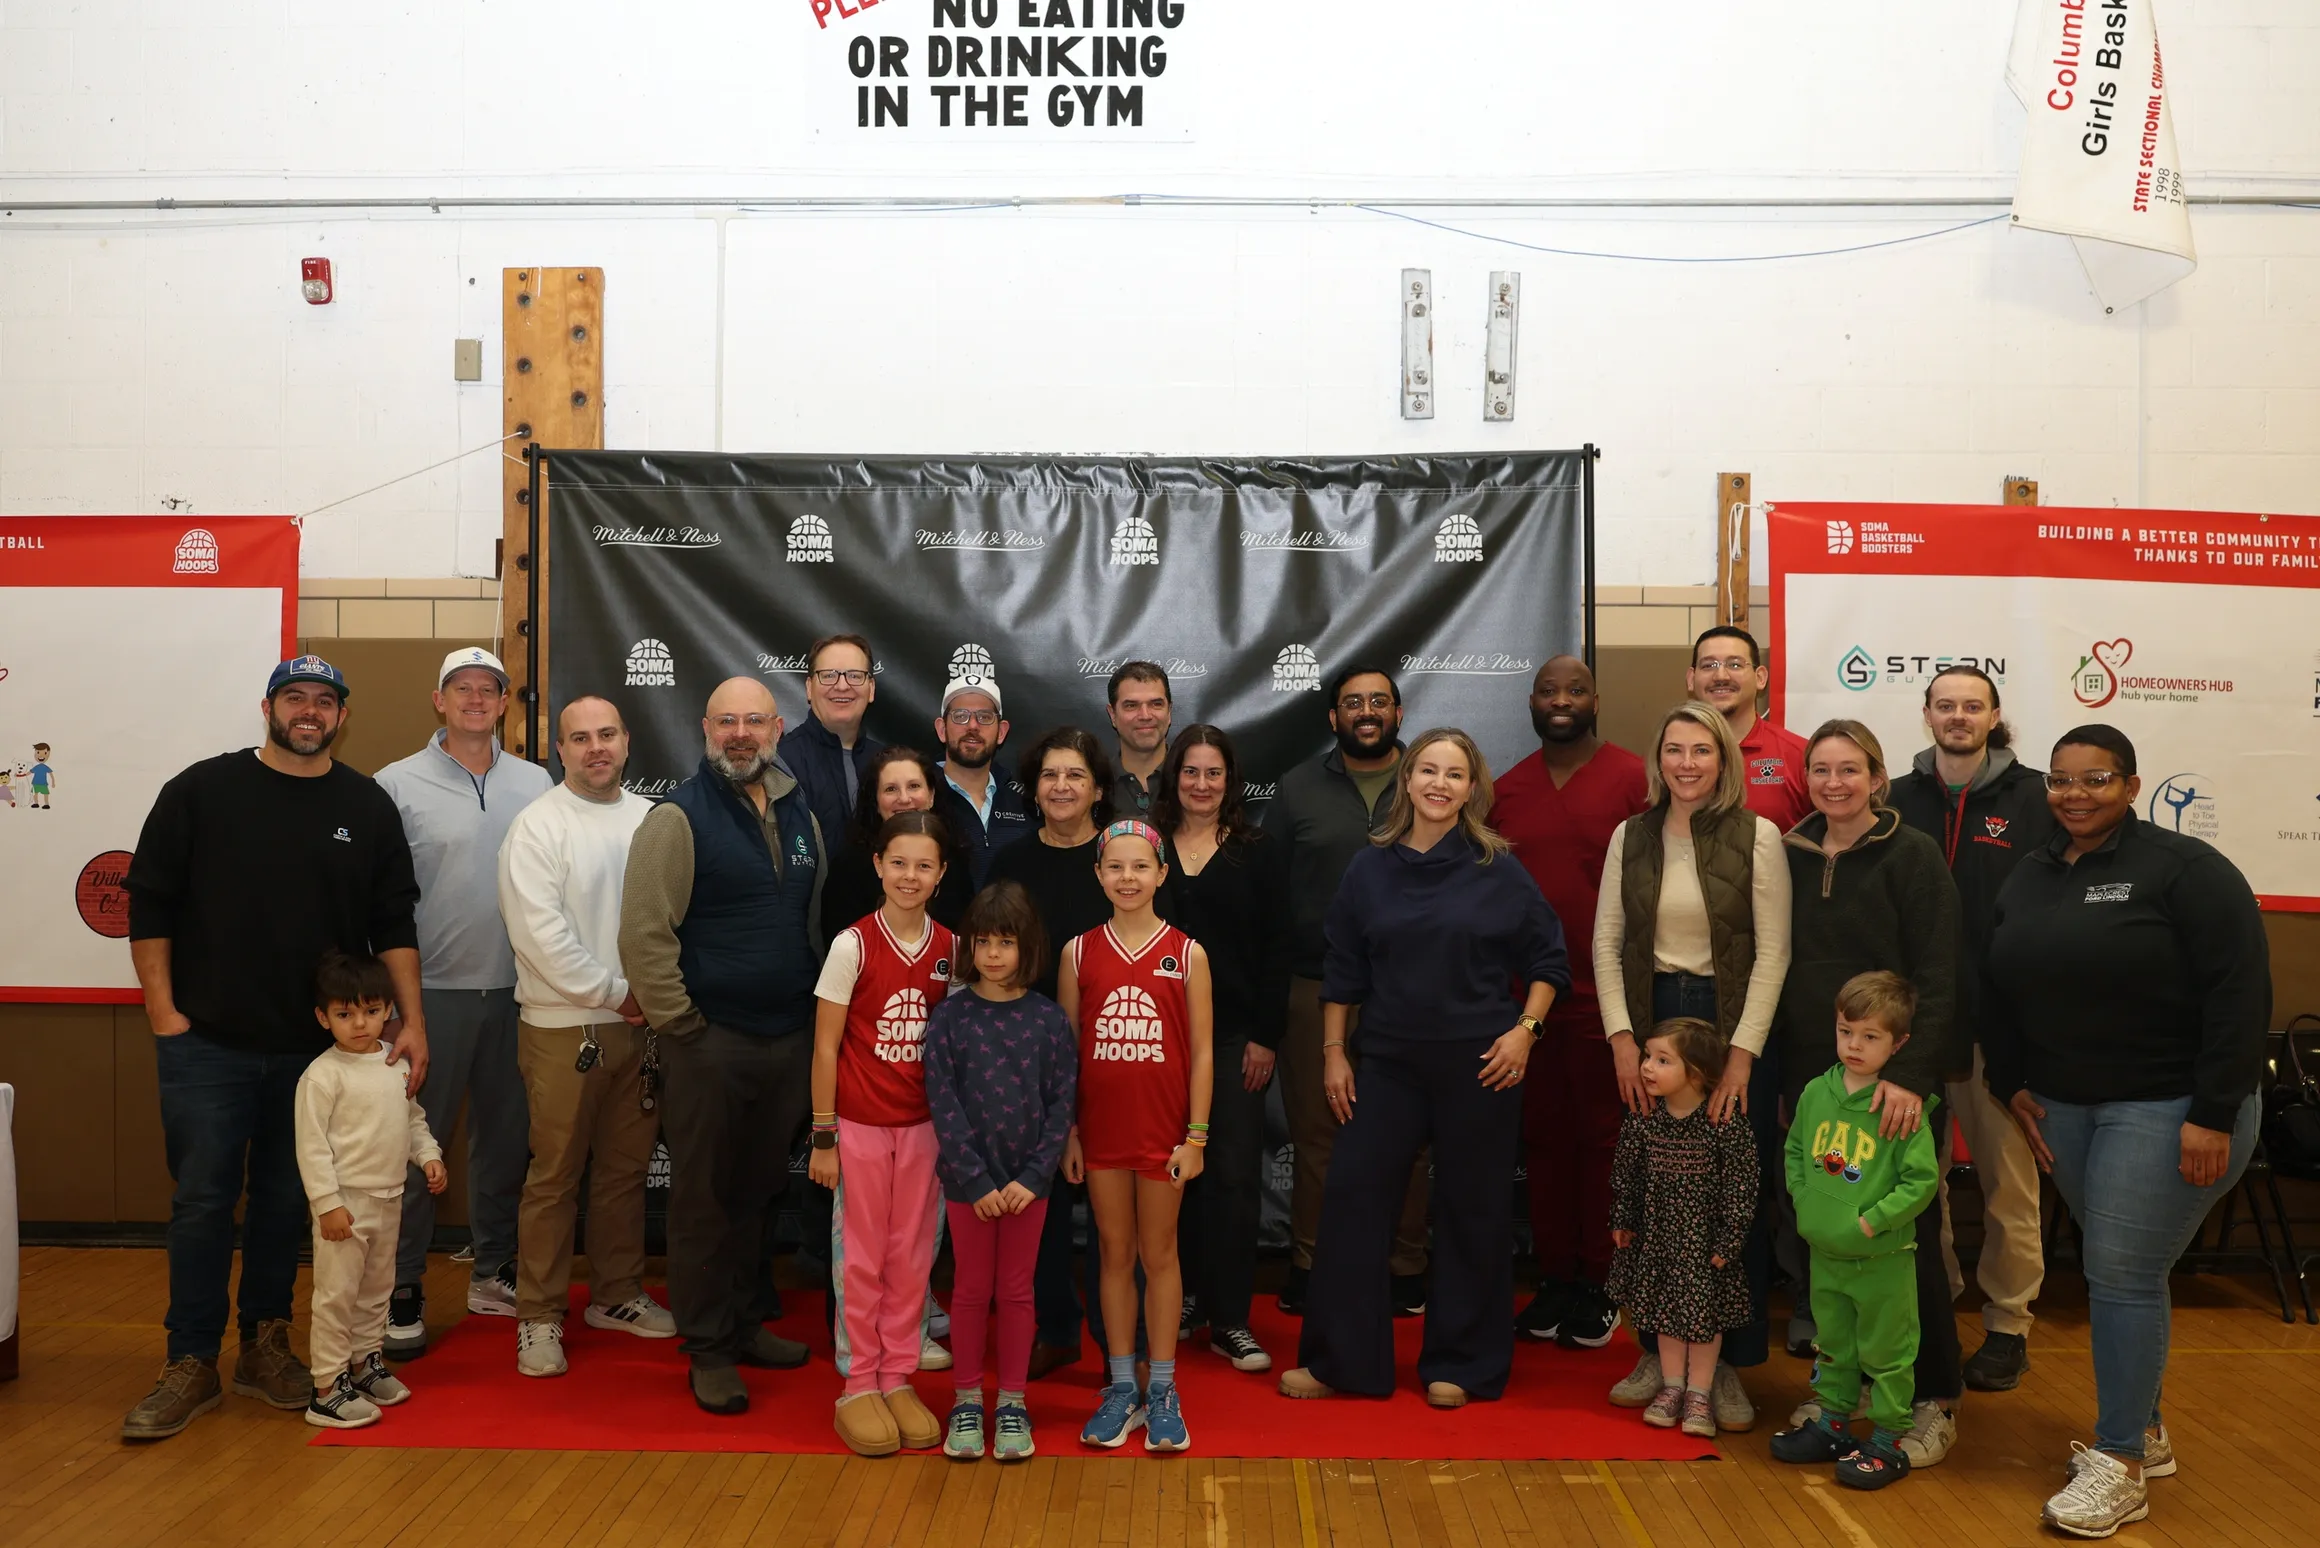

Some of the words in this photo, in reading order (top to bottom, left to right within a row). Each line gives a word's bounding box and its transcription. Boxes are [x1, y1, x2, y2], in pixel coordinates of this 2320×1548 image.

[933, 0, 998, 29] NO
[848, 35, 909, 78] OR
[927, 35, 1168, 78] DRINKING
[857, 85, 909, 128] IN
[930, 85, 1029, 128] THE
[1048, 84, 1143, 128] GYM
[2081, 82, 2117, 156] Girls
[2139, 94, 2162, 168] SECTIONAL
[2133, 171, 2151, 213] STATE
[2154, 167, 2171, 202] 1998
[592, 524, 666, 543] Mitchell
[666, 528, 678, 542] &
[679, 526, 722, 544] Ness
[1860, 522, 1889, 532] SOMA
[785, 534, 833, 549] SOMA
[914, 528, 987, 546] Mitchell
[988, 532, 1001, 546] &
[1003, 529, 1046, 548] Ness
[1240, 529, 1312, 546] Mitchell
[1312, 531, 1325, 546] &
[1327, 530, 1369, 547] Ness
[1435, 534, 1483, 549] SOMA
[1861, 532, 1925, 543] BASKETBALL
[2037, 525, 2114, 541] BUILDING
[2121, 528, 2131, 541] A
[2139, 529, 2198, 545] BETTER
[2206, 532, 2301, 548] COMMUNITY
[1110, 537, 1158, 552] SOMA
[1861, 543, 1913, 554] BOOSTERS
[178, 547, 215, 559] SOMA
[785, 550, 834, 563] HOOPS
[1109, 552, 1160, 565] HOOPS
[1434, 550, 1484, 562] HOOPS
[2134, 548, 2198, 564] THANKS
[2206, 551, 2225, 565] TO
[2233, 552, 2264, 566] OUR
[2272, 554, 2320, 569] FAMIL
[176, 560, 216, 571] HOOPS
[625, 658, 674, 673] SOMA
[756, 652, 809, 669] Mitch
[1166, 657, 1208, 675] Ness
[1400, 653, 1472, 670] Mitchell
[1475, 656, 1488, 669] &
[1490, 653, 1533, 670] Ness
[948, 663, 995, 678] SOMA
[1271, 663, 1320, 678] SOMA
[624, 673, 676, 686] HOOPS
[1271, 679, 1322, 691] HOOPS
[2121, 677, 2207, 691] HOMEOWNERS
[2209, 680, 2234, 692] HUB
[2120, 690, 2141, 700] hub
[2143, 693, 2167, 703] your
[2168, 691, 2199, 703] home
[2194, 803, 2215, 811] Head
[2192, 811, 2200, 819] to
[2202, 812, 2215, 820] Toe
[2188, 820, 2219, 830] Physical
[2189, 828, 2219, 839] Therapy
[2277, 830, 2308, 840] SPEAR
[876, 1019, 929, 1041] SOM
[1095, 1017, 1163, 1041] SOMA
[874, 1042, 927, 1063] HOOP
[1093, 1042, 1166, 1063] HOOPS
[1811, 1120, 1877, 1168] GAP
